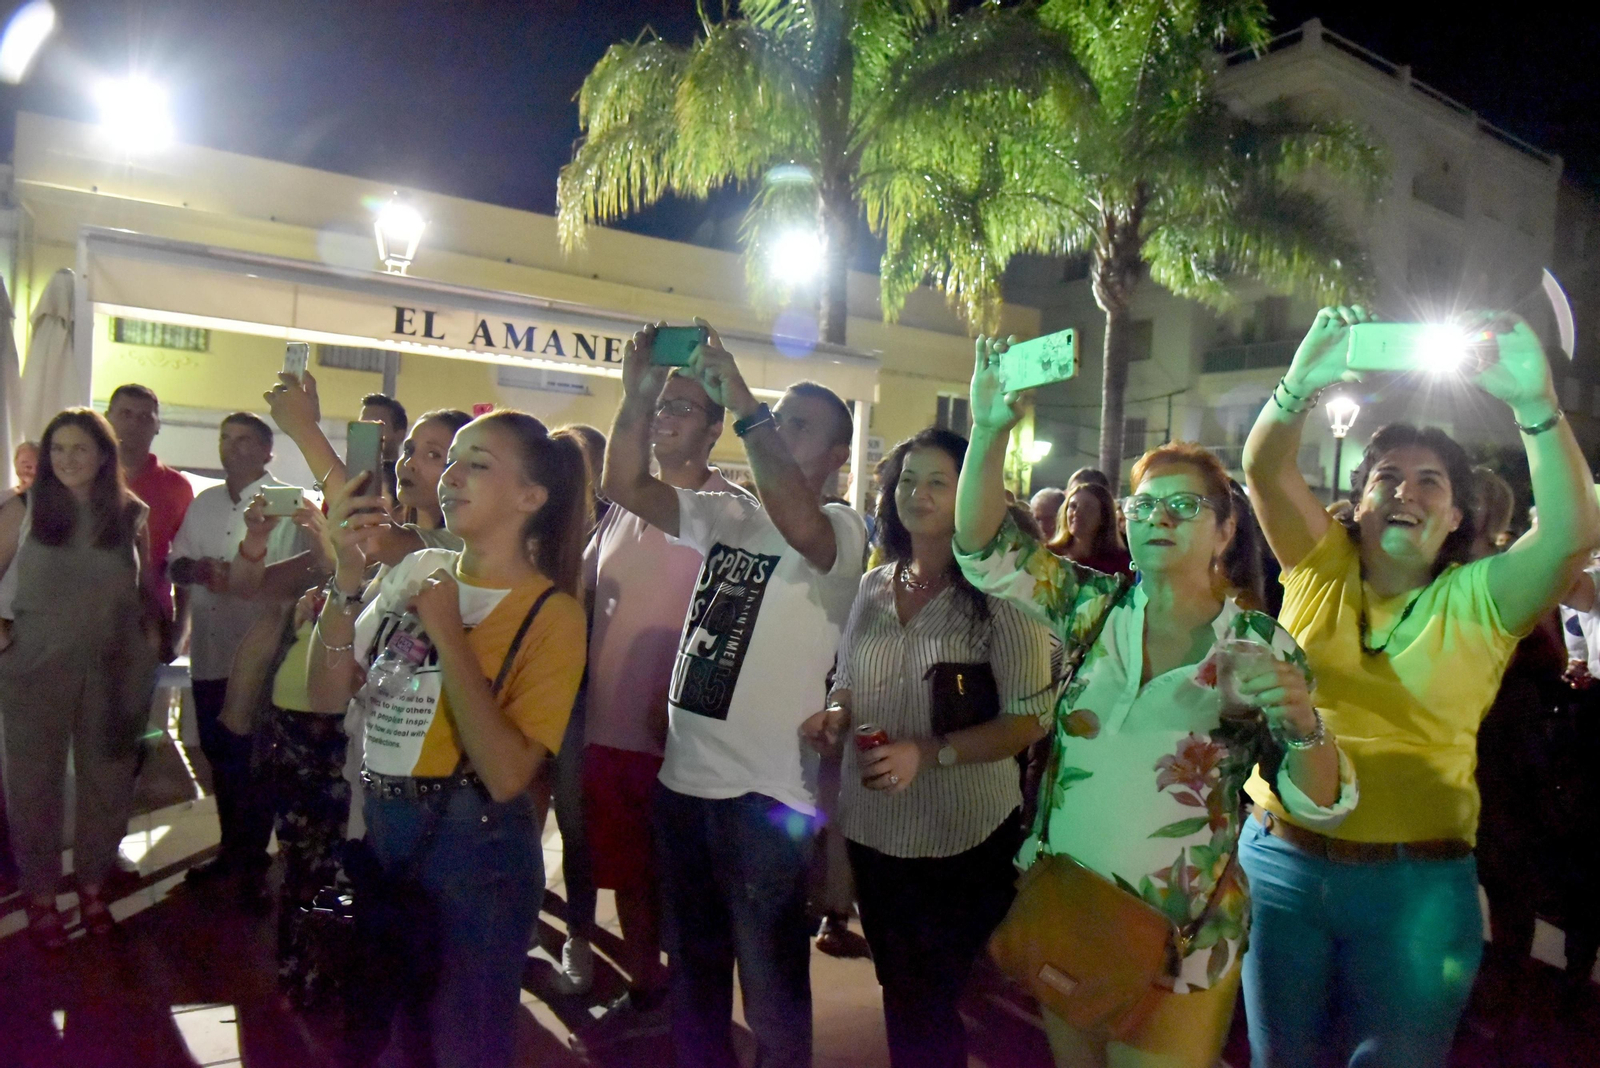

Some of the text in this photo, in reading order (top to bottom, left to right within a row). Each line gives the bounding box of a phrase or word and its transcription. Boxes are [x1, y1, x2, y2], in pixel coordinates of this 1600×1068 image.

[391, 306, 445, 340] EL
[723, 629, 744, 659] TIME
[406, 707, 434, 715] others.
